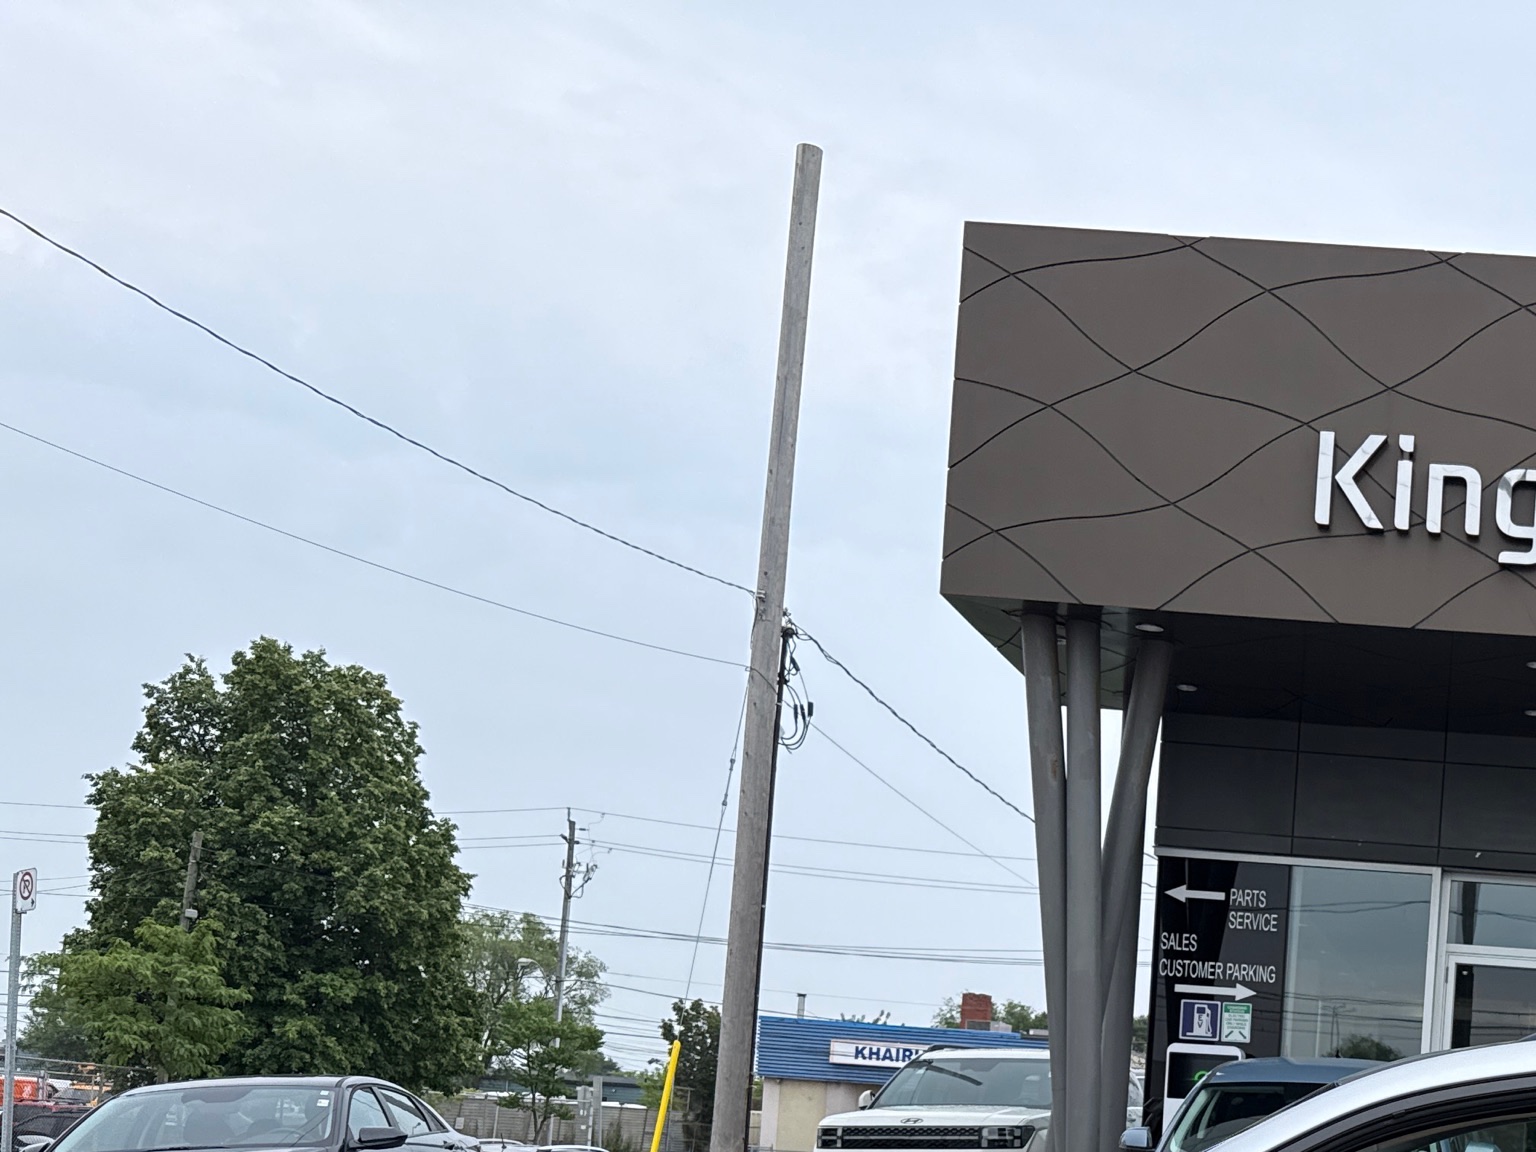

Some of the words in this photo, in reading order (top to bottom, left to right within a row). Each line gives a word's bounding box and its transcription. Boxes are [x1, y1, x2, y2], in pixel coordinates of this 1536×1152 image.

[1229, 888, 1267, 908] PARTS
[1228, 911, 1278, 932] SERVICE
[1160, 932, 1198, 952] SALES
[1159, 958, 1224, 980] CUSTOMER
[1226, 963, 1276, 984] PARKING
[854, 1046, 919, 1063] KHAIR
